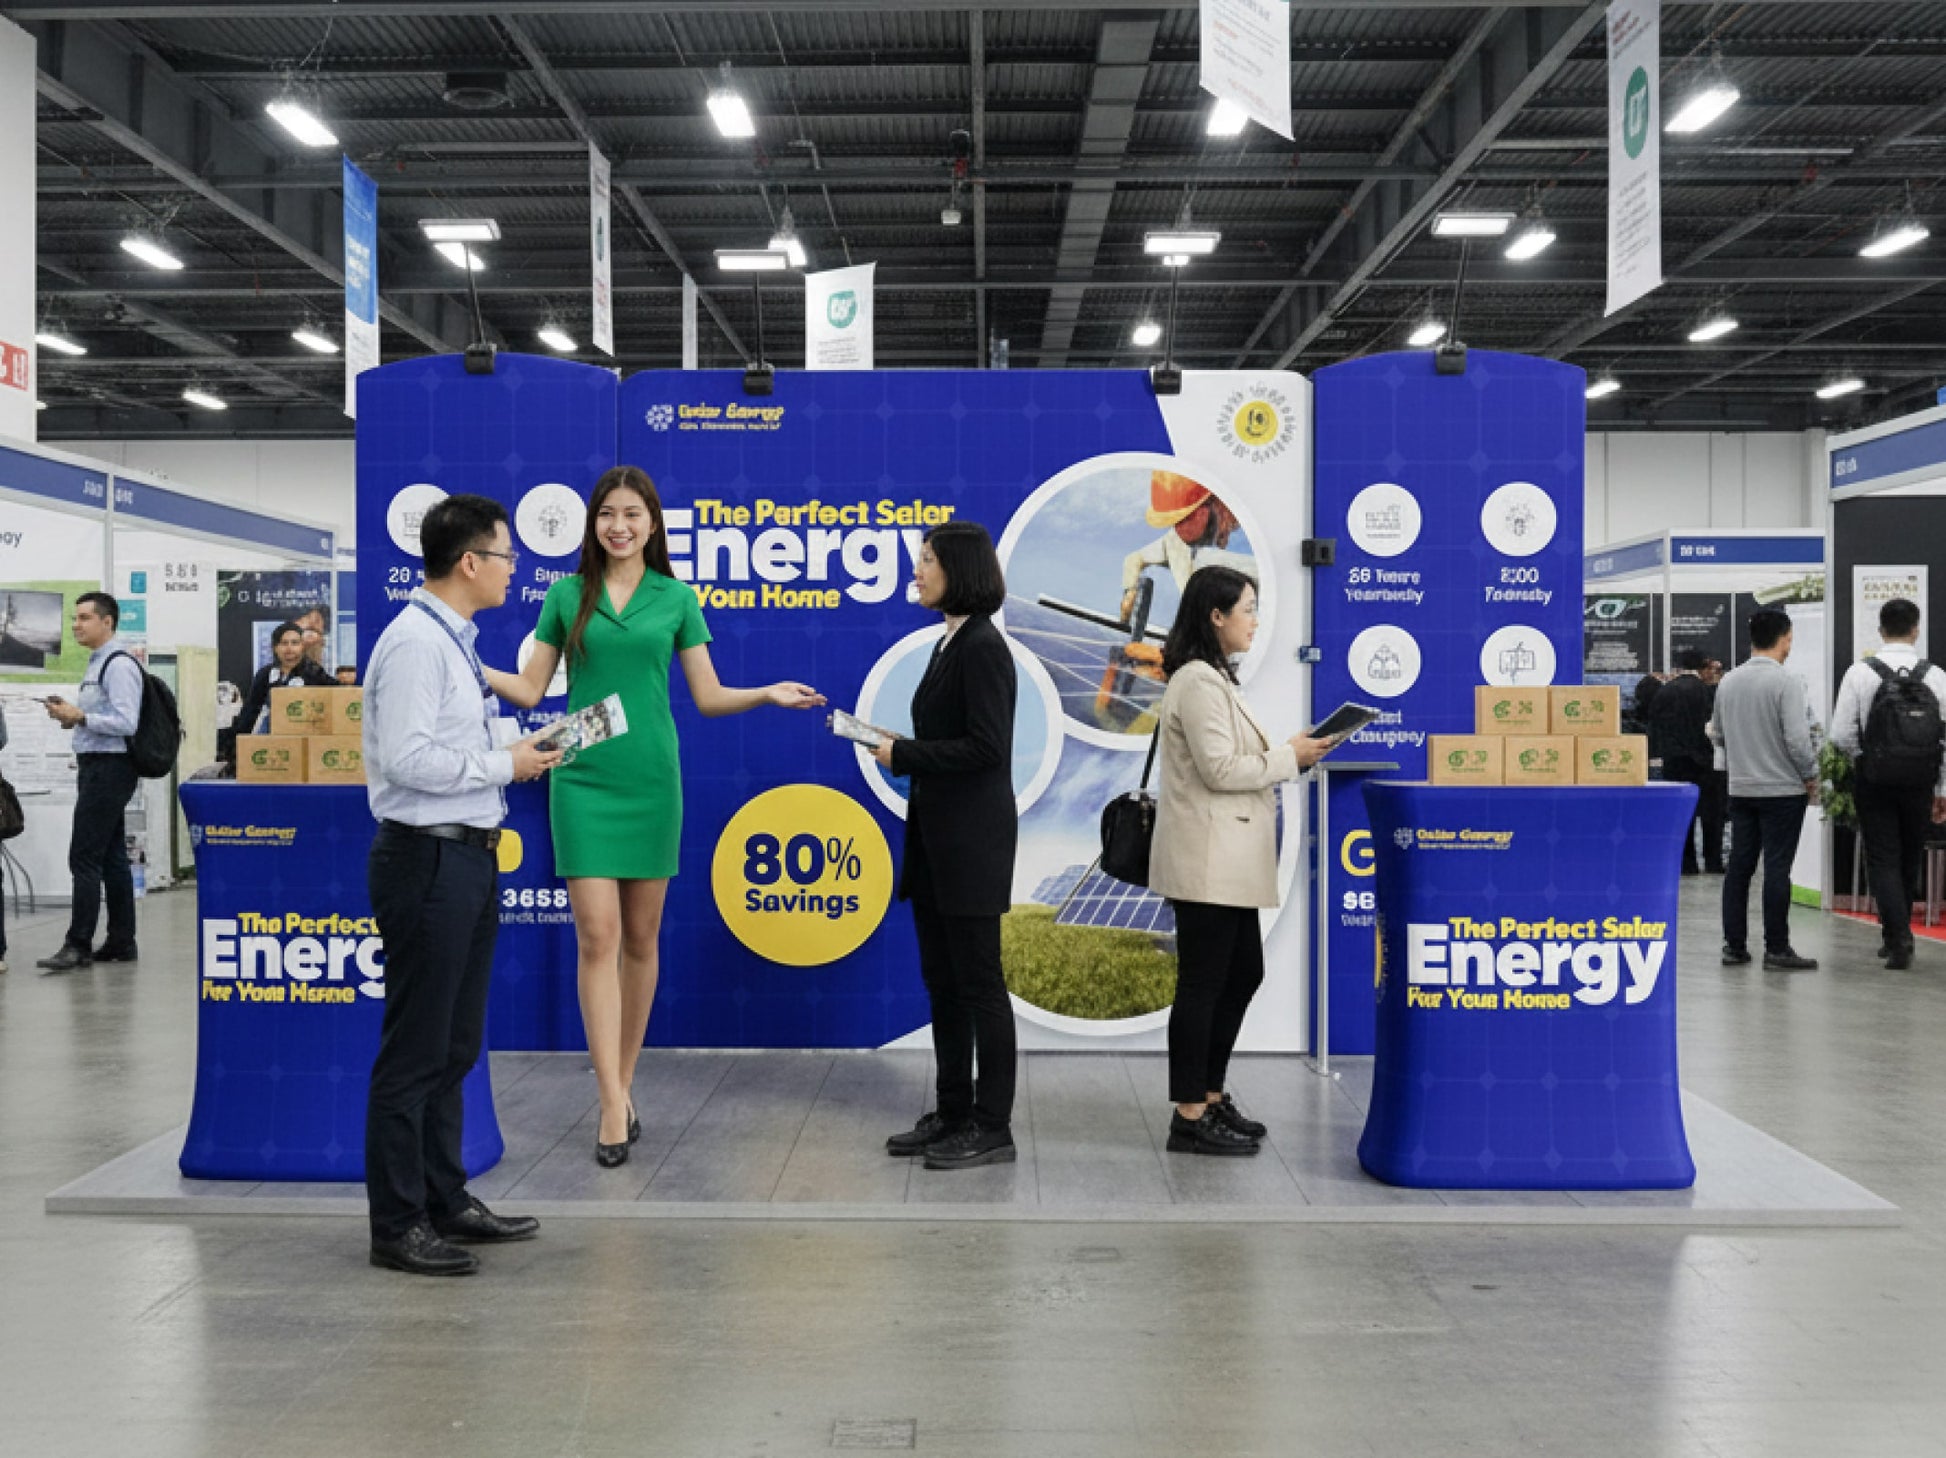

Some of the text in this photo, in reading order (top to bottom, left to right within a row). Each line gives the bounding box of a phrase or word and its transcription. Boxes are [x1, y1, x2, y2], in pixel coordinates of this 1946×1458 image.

[743, 832, 862, 885] 80%
[745, 888, 860, 920] Savings
[202, 918, 386, 999] Energ
[1407, 923, 1669, 1006] Energy
